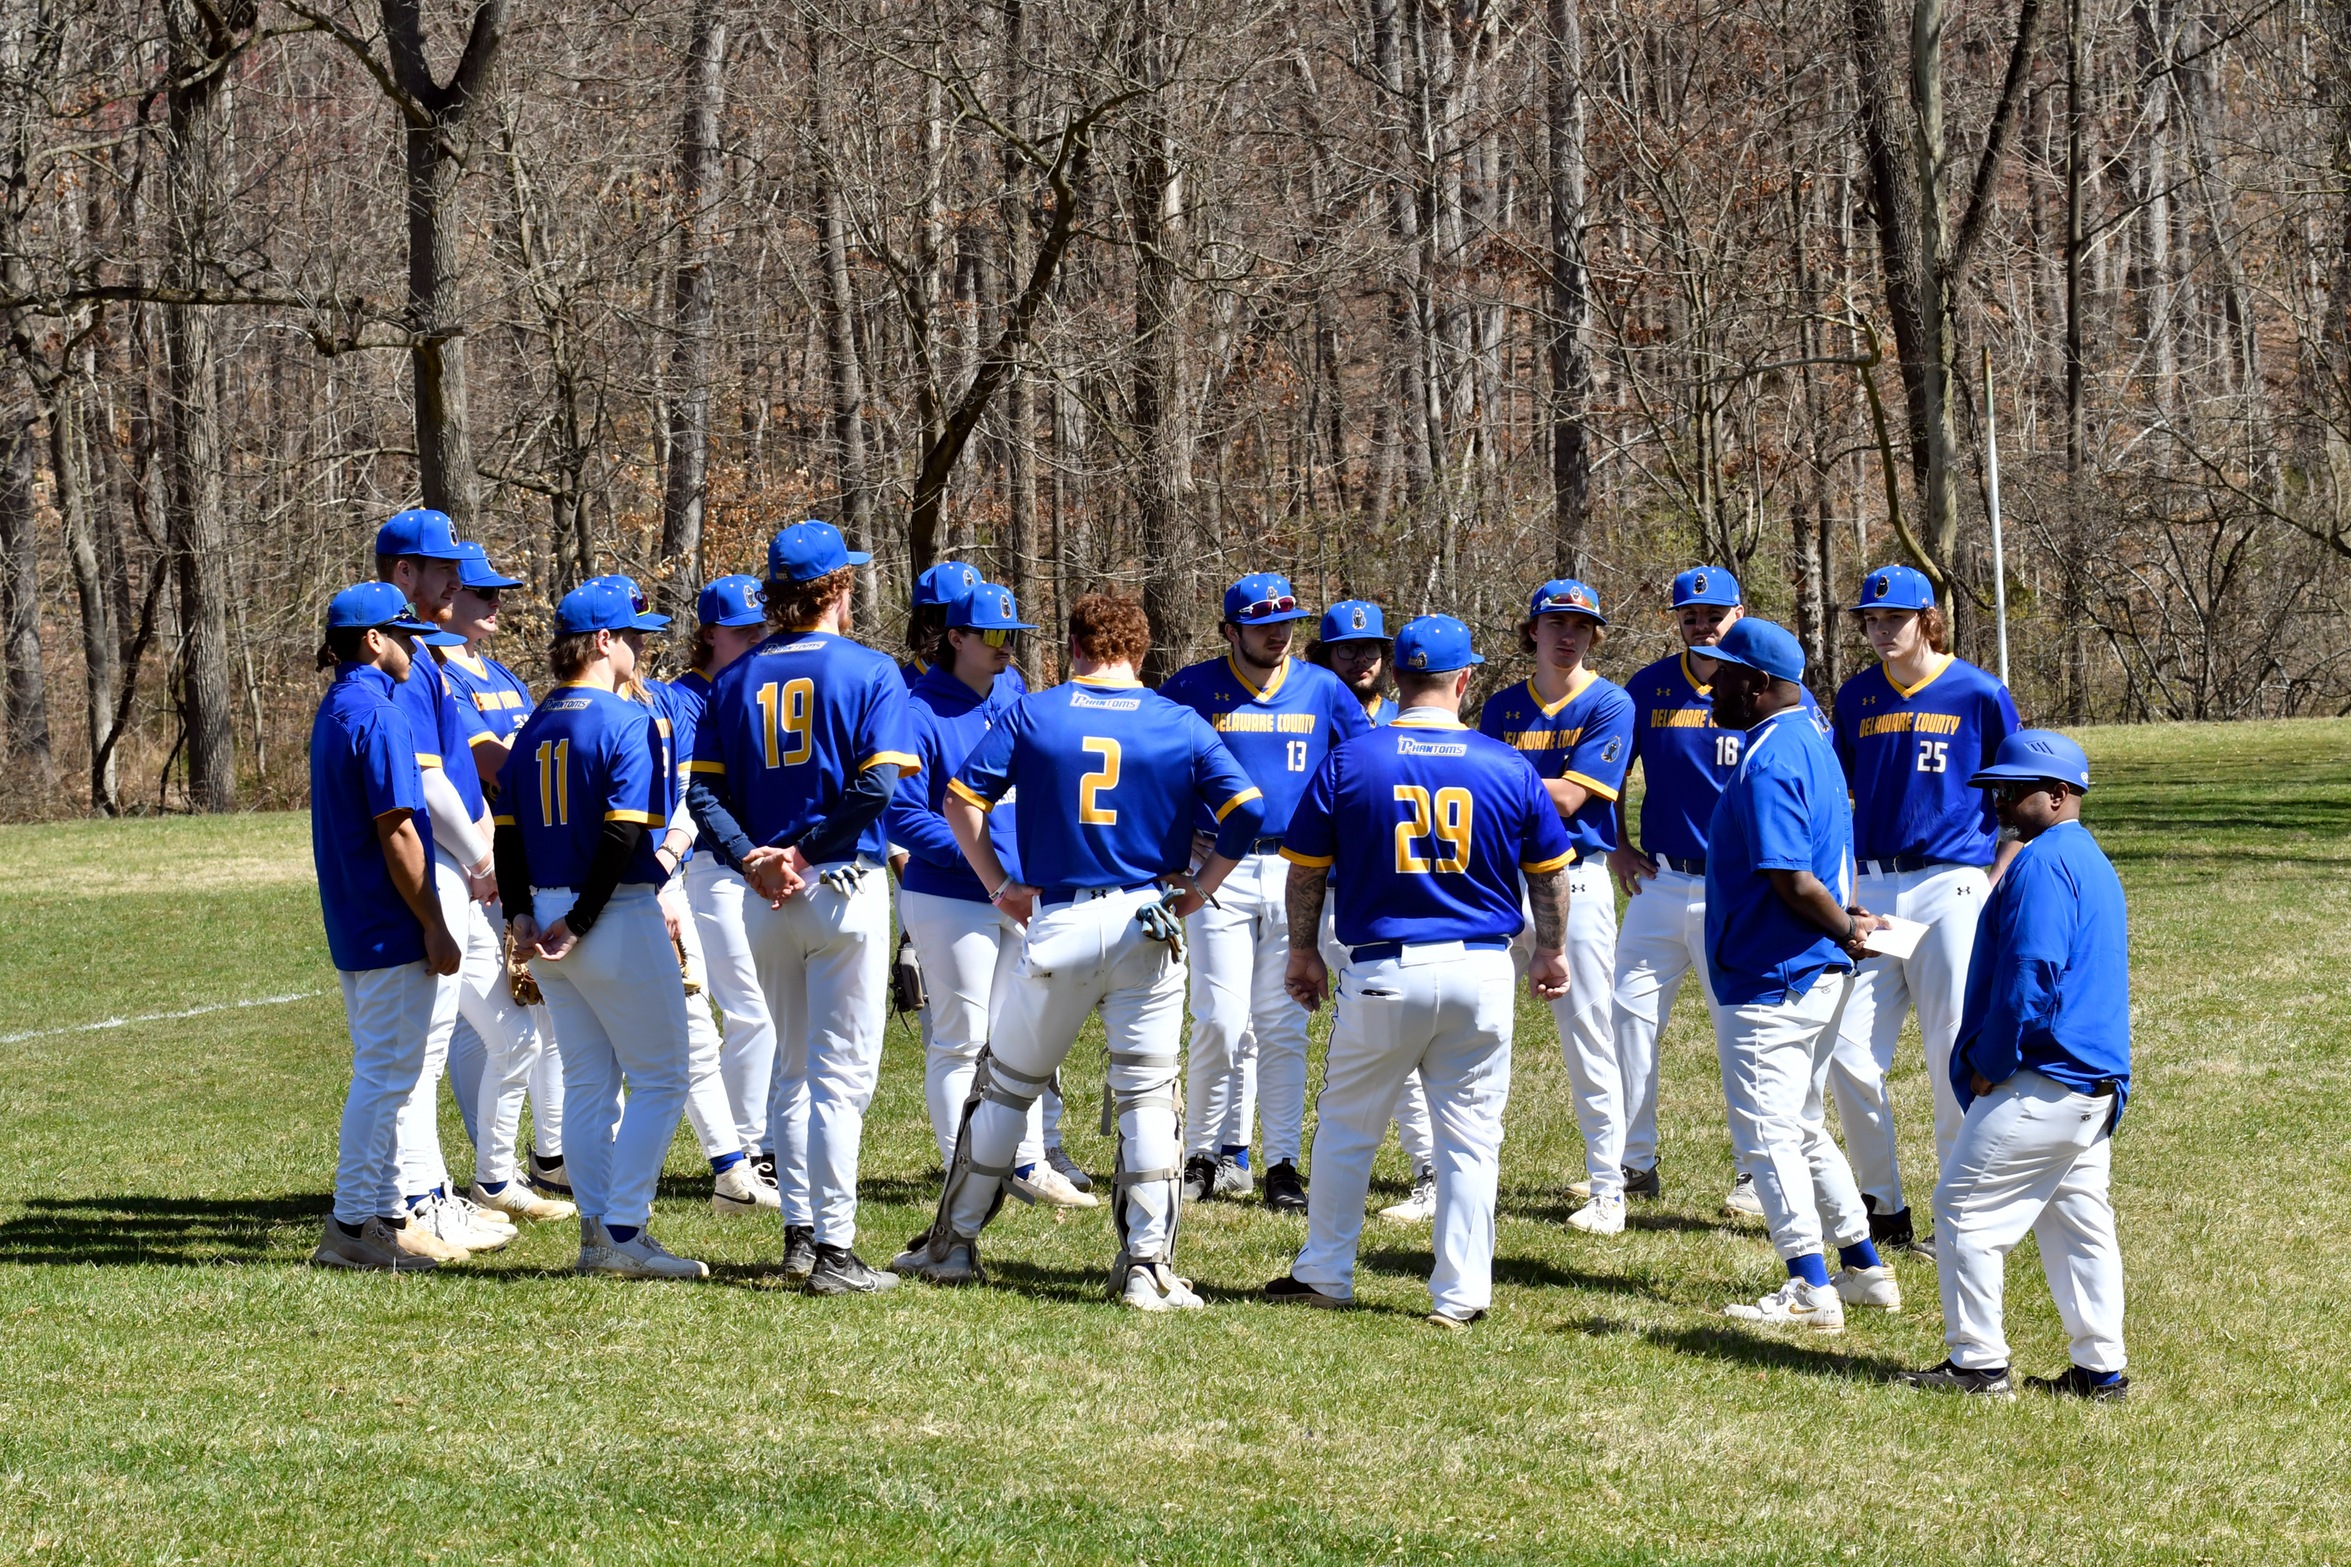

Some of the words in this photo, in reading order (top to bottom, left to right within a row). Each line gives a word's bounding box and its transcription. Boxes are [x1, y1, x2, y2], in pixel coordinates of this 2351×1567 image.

[1072, 694, 1138, 710] PHANTOMS
[757, 677, 814, 769] 19
[1212, 713, 1274, 732] DELAWARE
[1277, 714, 1316, 734] COUNTY
[1651, 709, 1708, 728] DELAWARE
[1859, 712, 1914, 738] DELAWARE
[1914, 713, 1961, 735] COUNTY
[1398, 737, 1466, 756] PHANTOMS
[1504, 730, 1556, 750] ELAWARE
[1287, 740, 1307, 772] 13
[1917, 740, 1948, 773] 25
[535, 738, 569, 827] 11
[1079, 736, 1122, 826] 2
[1393, 785, 1473, 874] 29
